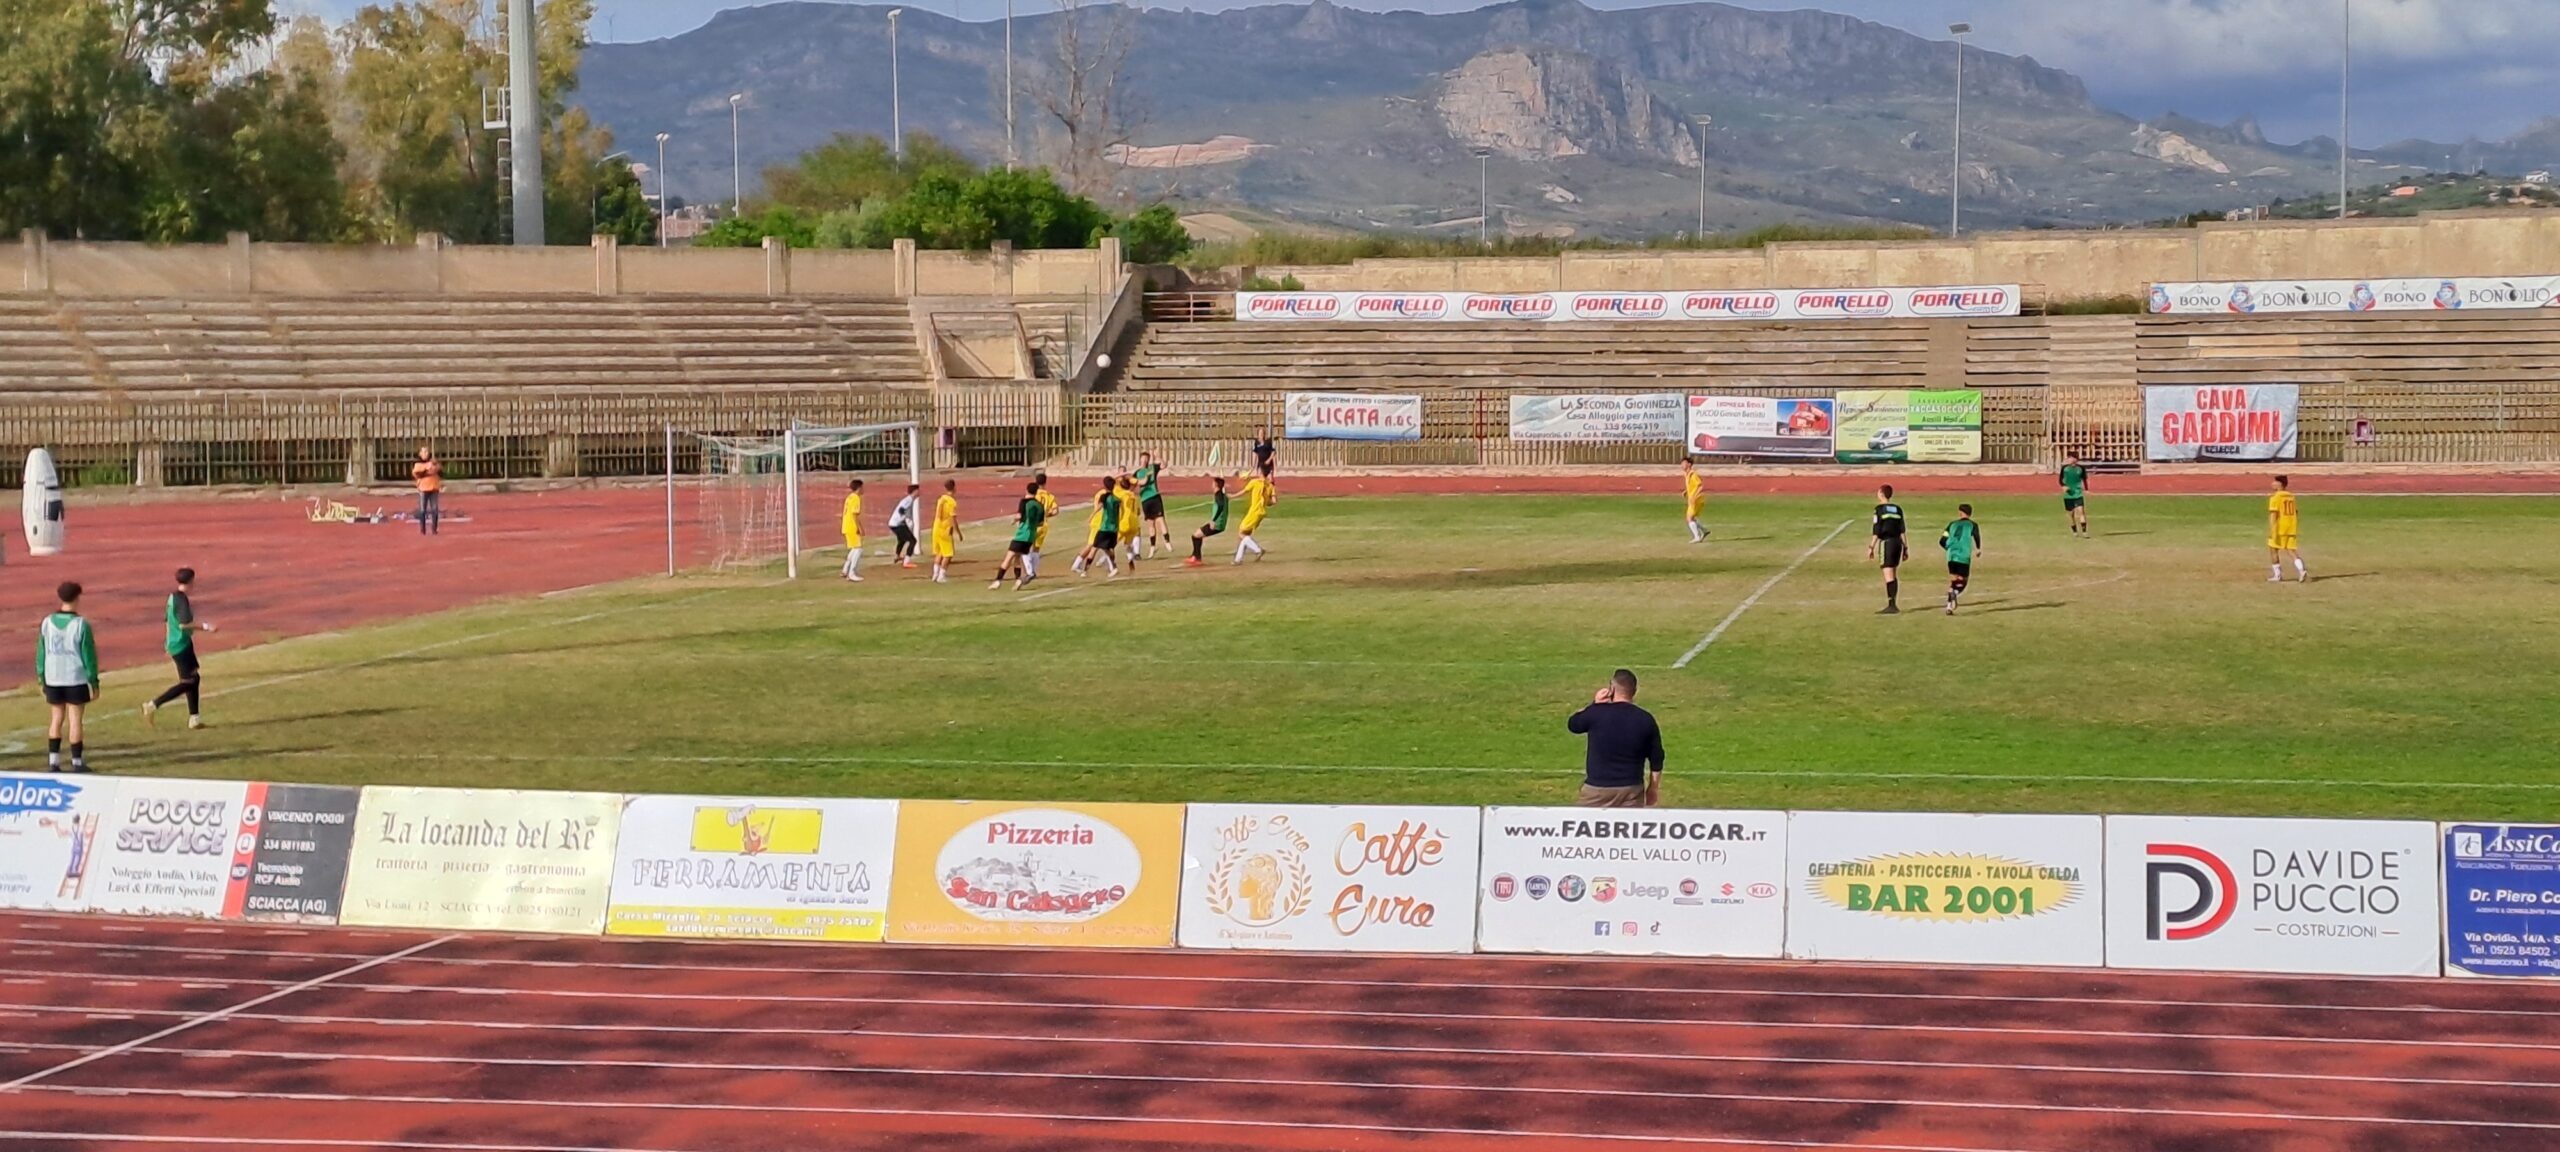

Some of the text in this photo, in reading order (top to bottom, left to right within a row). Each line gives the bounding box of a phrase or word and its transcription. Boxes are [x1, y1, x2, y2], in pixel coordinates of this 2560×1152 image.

[1250, 298, 1337, 312] PORRELLO
[1357, 298, 1444, 312] PORRELLO
[1466, 298, 1554, 312] PORRELLO
[1574, 297, 1663, 311] PORRELLO
[1686, 296, 1776, 310] PORRELLO
[1797, 294, 1889, 309] PORRELLO
[1911, 291, 2004, 307] PORRELLO
[2179, 295, 2221, 306] BONO
[2383, 292, 2426, 304] BONO
[1577, 397, 1621, 410] SECONDA
[1624, 397, 1681, 410] GIOVINEZZA
[2196, 388, 2248, 410] CAVA
[1316, 407, 1380, 427] LICATA
[1588, 411, 1625, 422] Alloggio
[1627, 412, 1641, 422] per
[1642, 411, 1675, 420] Anziani
[2162, 411, 2281, 445] GADDIMI
[2282, 499, 2296, 517] 10
[129, 798, 227, 825] POGGI
[266, 811, 345, 825] VINCENZO POGGI
[380, 811, 411, 845] La
[421, 816, 508, 849] locanda
[515, 819, 551, 850] del
[986, 822, 1094, 845] Pizzeria
[117, 828, 227, 856] SERVICE
[1334, 819, 1451, 877] Caffè
[1541, 846, 1727, 865] MAZARA DEL VALLO (TP)
[2253, 849, 2400, 880] DAVIDE
[505, 863, 587, 877] gastronomia
[632, 857, 871, 894] FERRAMENTA
[1808, 862, 1876, 878] GELATERIA
[1888, 864, 1972, 879] PASTICCERIA
[1986, 866, 2034, 880] TAVOLA
[2038, 867, 2081, 882] CALDA
[945, 876, 1126, 914] San Calogero
[1622, 881, 1669, 899] Jeep
[1750, 886, 1773, 896] KIA
[1847, 883, 2035, 915] BAR 2001
[2469, 888, 2491, 903] Dr.
[2495, 889, 2537, 904] Piero
[247, 896, 327, 914] SCIACCA (AG)
[2253, 884, 2400, 915] PUCCIO
[1324, 883, 1437, 937] Euro
[2276, 923, 2378, 938] COSTRUZIONI
[2464, 932, 2481, 942] Via
[2468, 944, 2486, 954] Tel.
[2489, 944, 2516, 955] 0925
